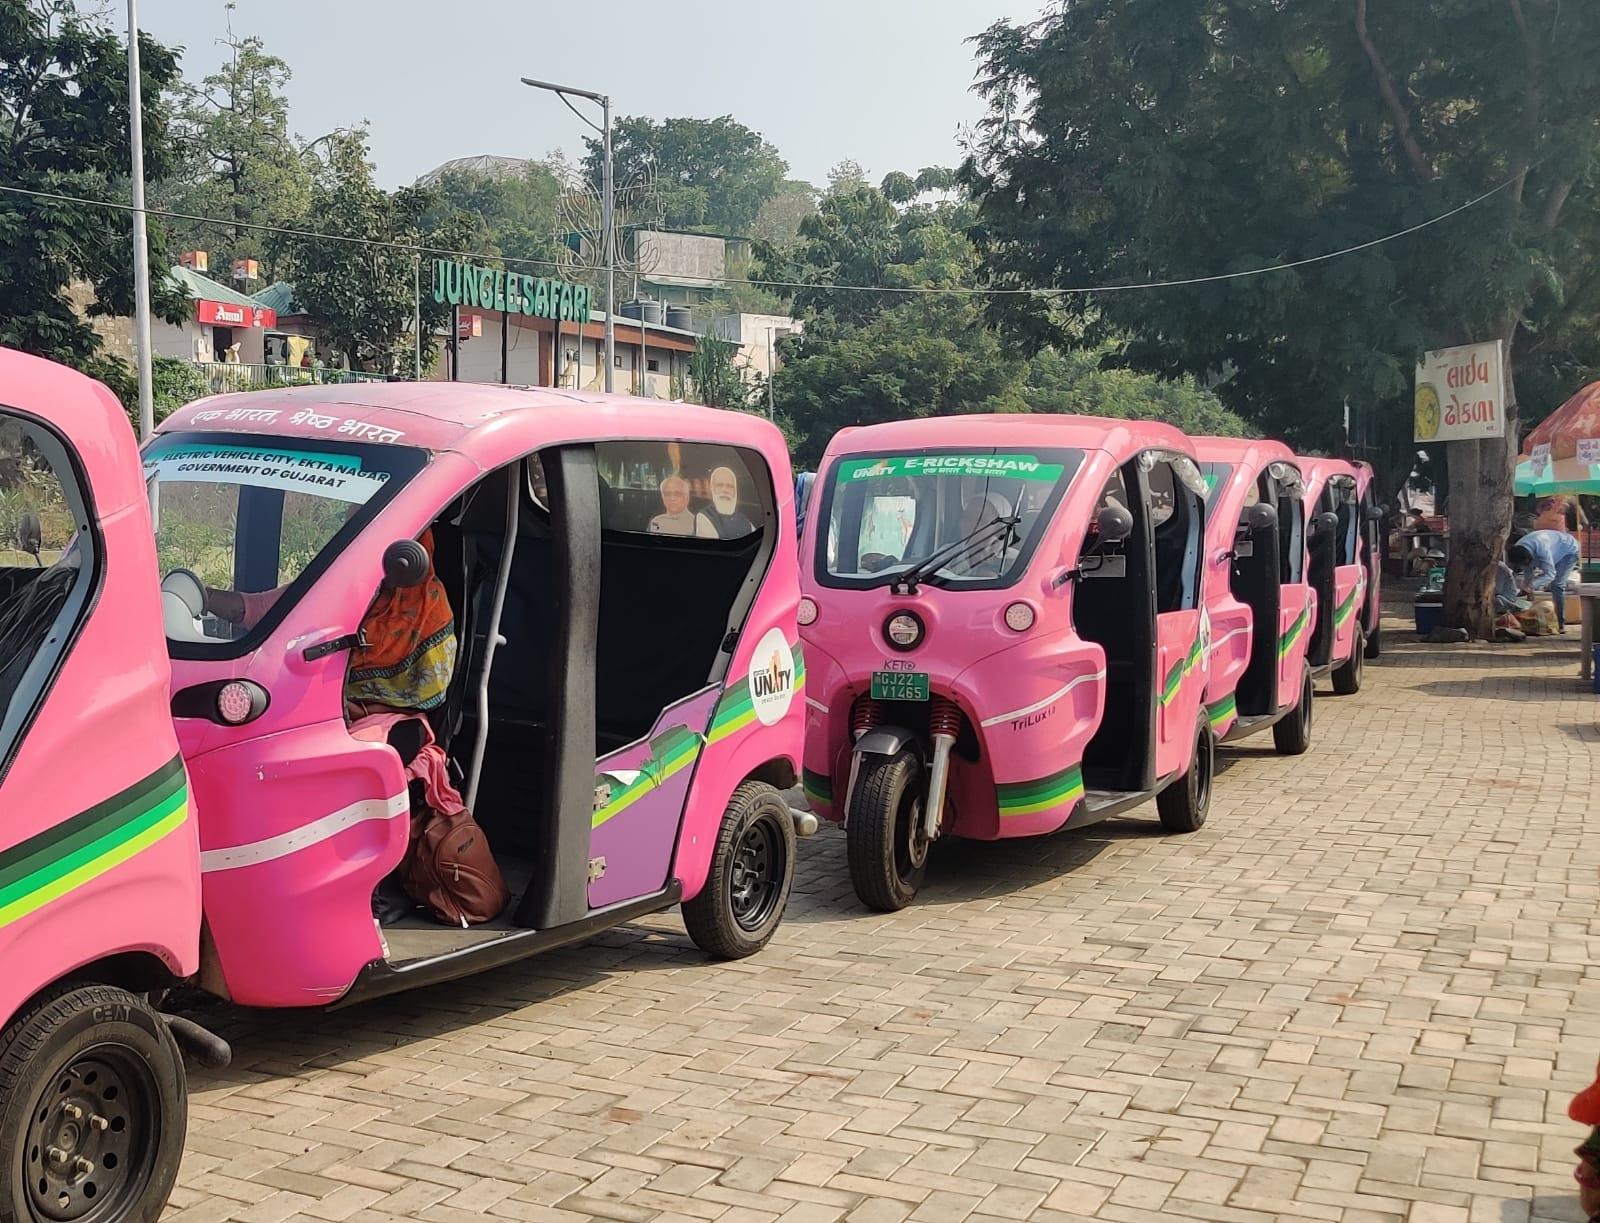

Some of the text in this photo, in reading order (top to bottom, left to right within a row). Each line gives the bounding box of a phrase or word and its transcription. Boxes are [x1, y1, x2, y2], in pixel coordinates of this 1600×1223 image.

[434, 260, 592, 324] JUNGLE SAFARI
[1446, 353, 1488, 388] લાઈવ
[1444, 394, 1495, 425] ઢોકળા
[191, 408, 405, 443] एक भारत, श्रेष्ठ भारत
[163, 451, 389, 482] ELECTRIC VEHICLE CITY, EKTA NAGAR
[177, 463, 346, 488] GOVERNMENT OF GUJARAT
[904, 457, 1040, 472] E-RICKSHAW
[881, 673, 914, 686] GJ22
[881, 685, 922, 699] V1465
[92, 1004, 132, 1022] CEAT
